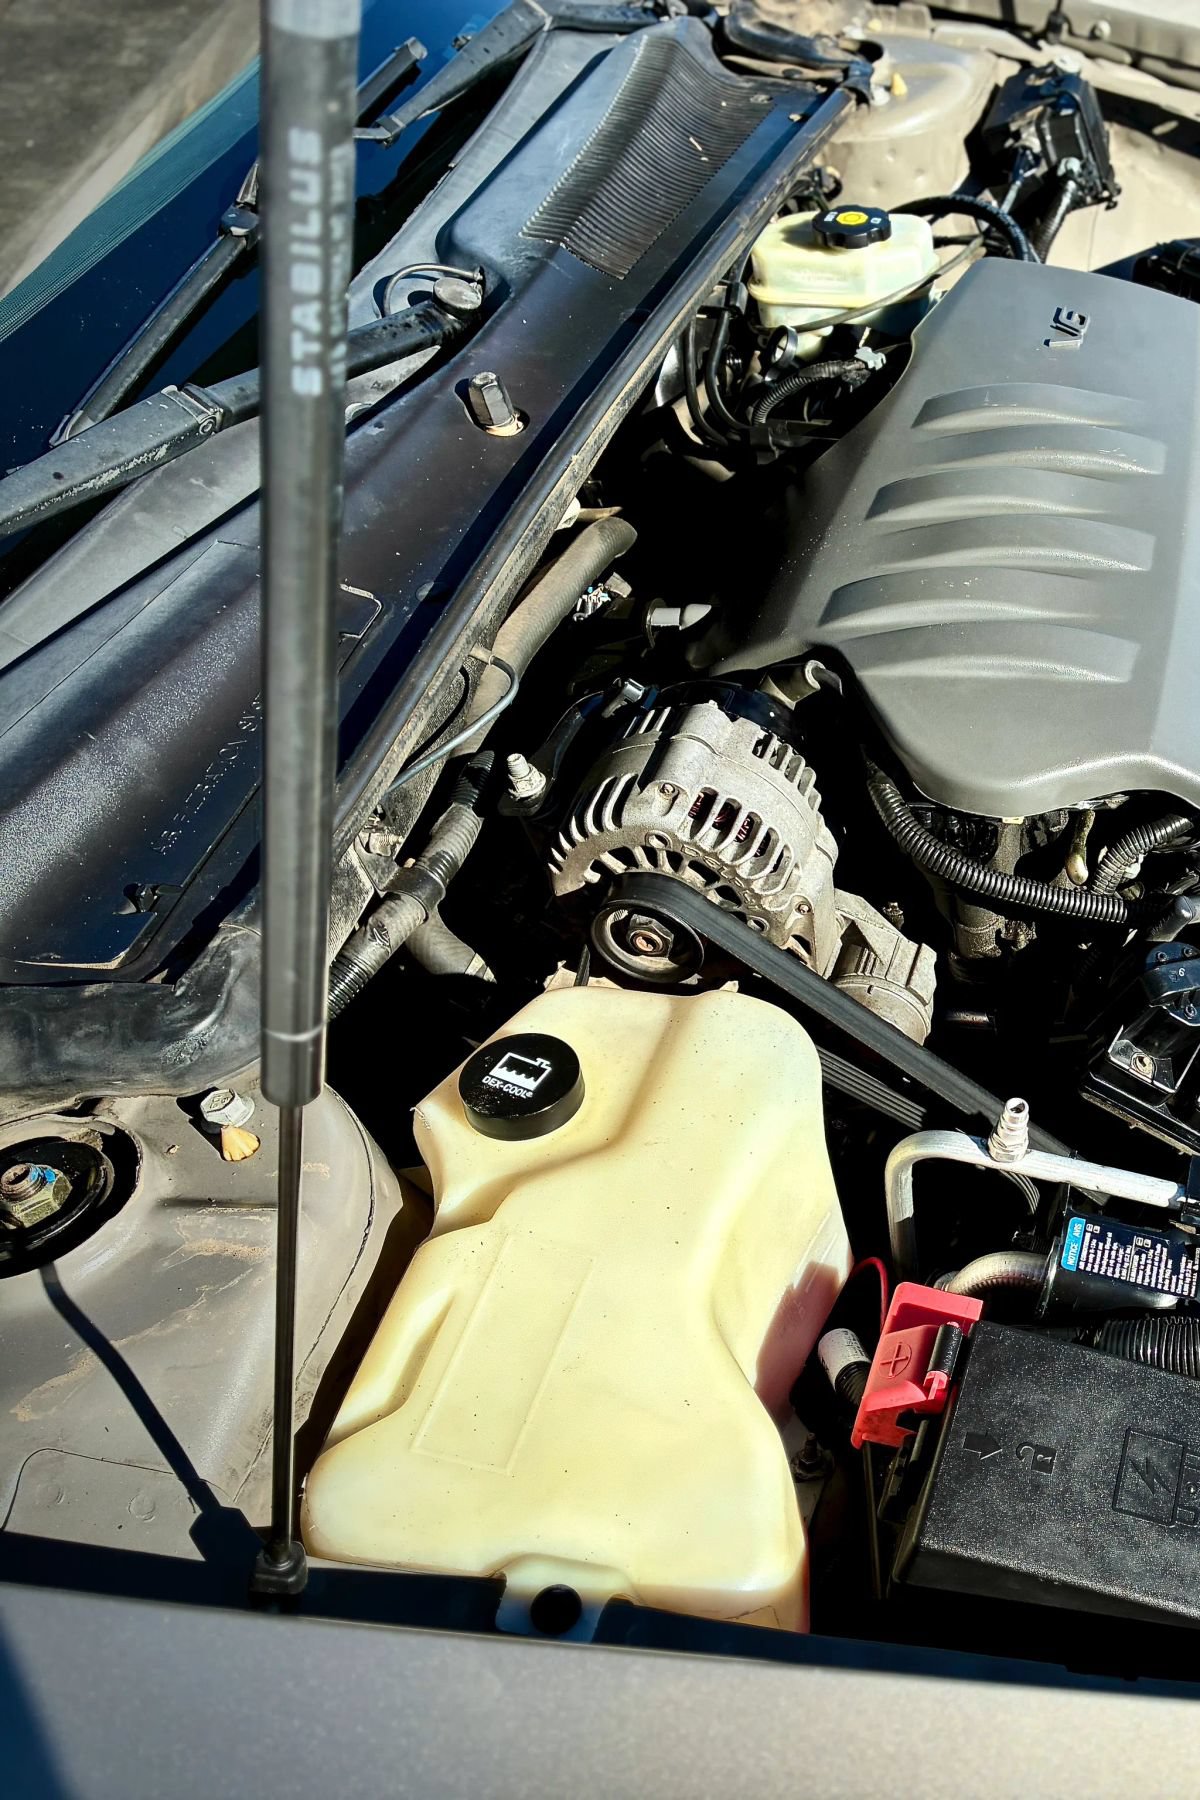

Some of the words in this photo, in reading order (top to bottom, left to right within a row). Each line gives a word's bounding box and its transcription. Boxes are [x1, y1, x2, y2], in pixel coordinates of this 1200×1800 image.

[288, 125, 323, 397] STABILUS
[1042, 305, 1090, 350] V6
[1067, 1243, 1077, 1265] NOTICE
